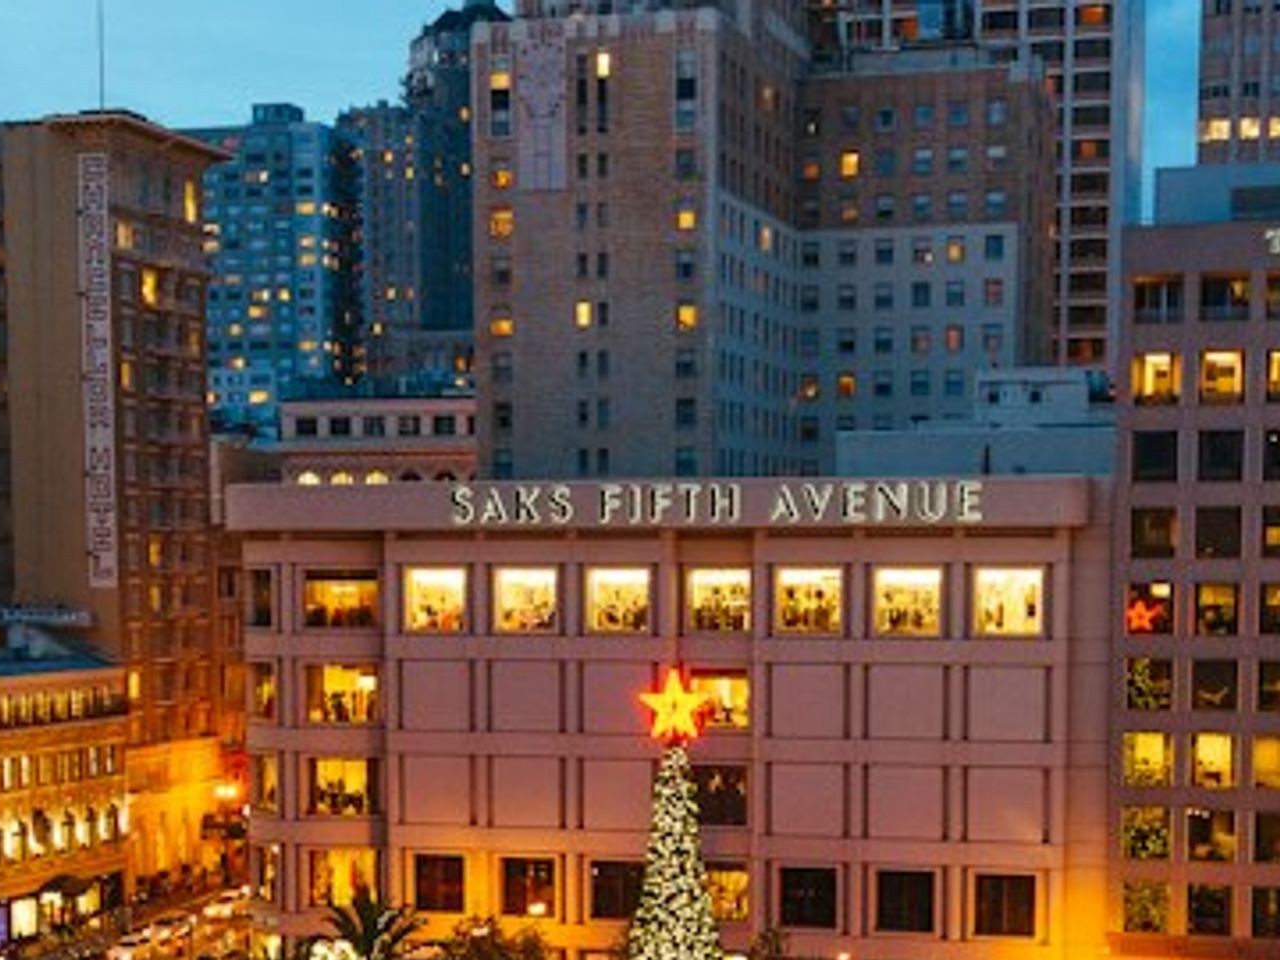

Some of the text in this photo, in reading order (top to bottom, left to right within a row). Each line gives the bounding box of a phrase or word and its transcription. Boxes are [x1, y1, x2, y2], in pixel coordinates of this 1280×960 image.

[453, 480, 985, 525] SAKS FIFTH AVENUE
